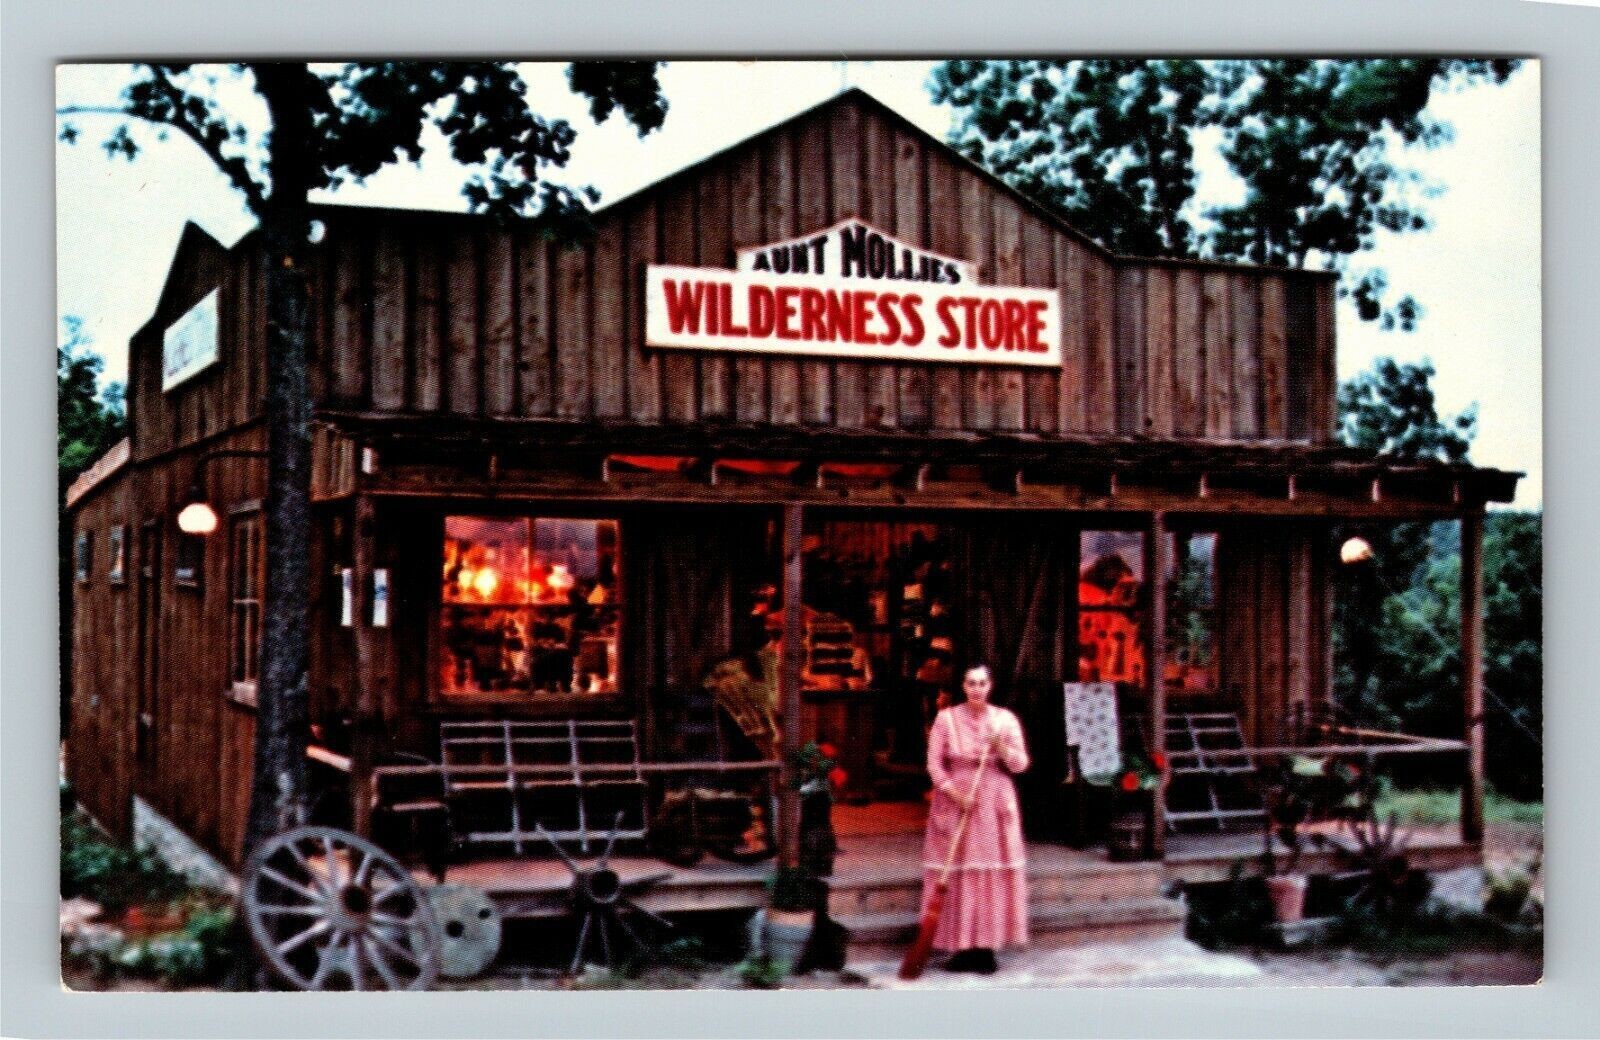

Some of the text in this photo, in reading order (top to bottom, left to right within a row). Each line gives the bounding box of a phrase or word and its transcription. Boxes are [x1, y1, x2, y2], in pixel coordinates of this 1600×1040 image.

[752, 236, 829, 275] AUNT
[663, 279, 1049, 353] WILDERNESS STORE
